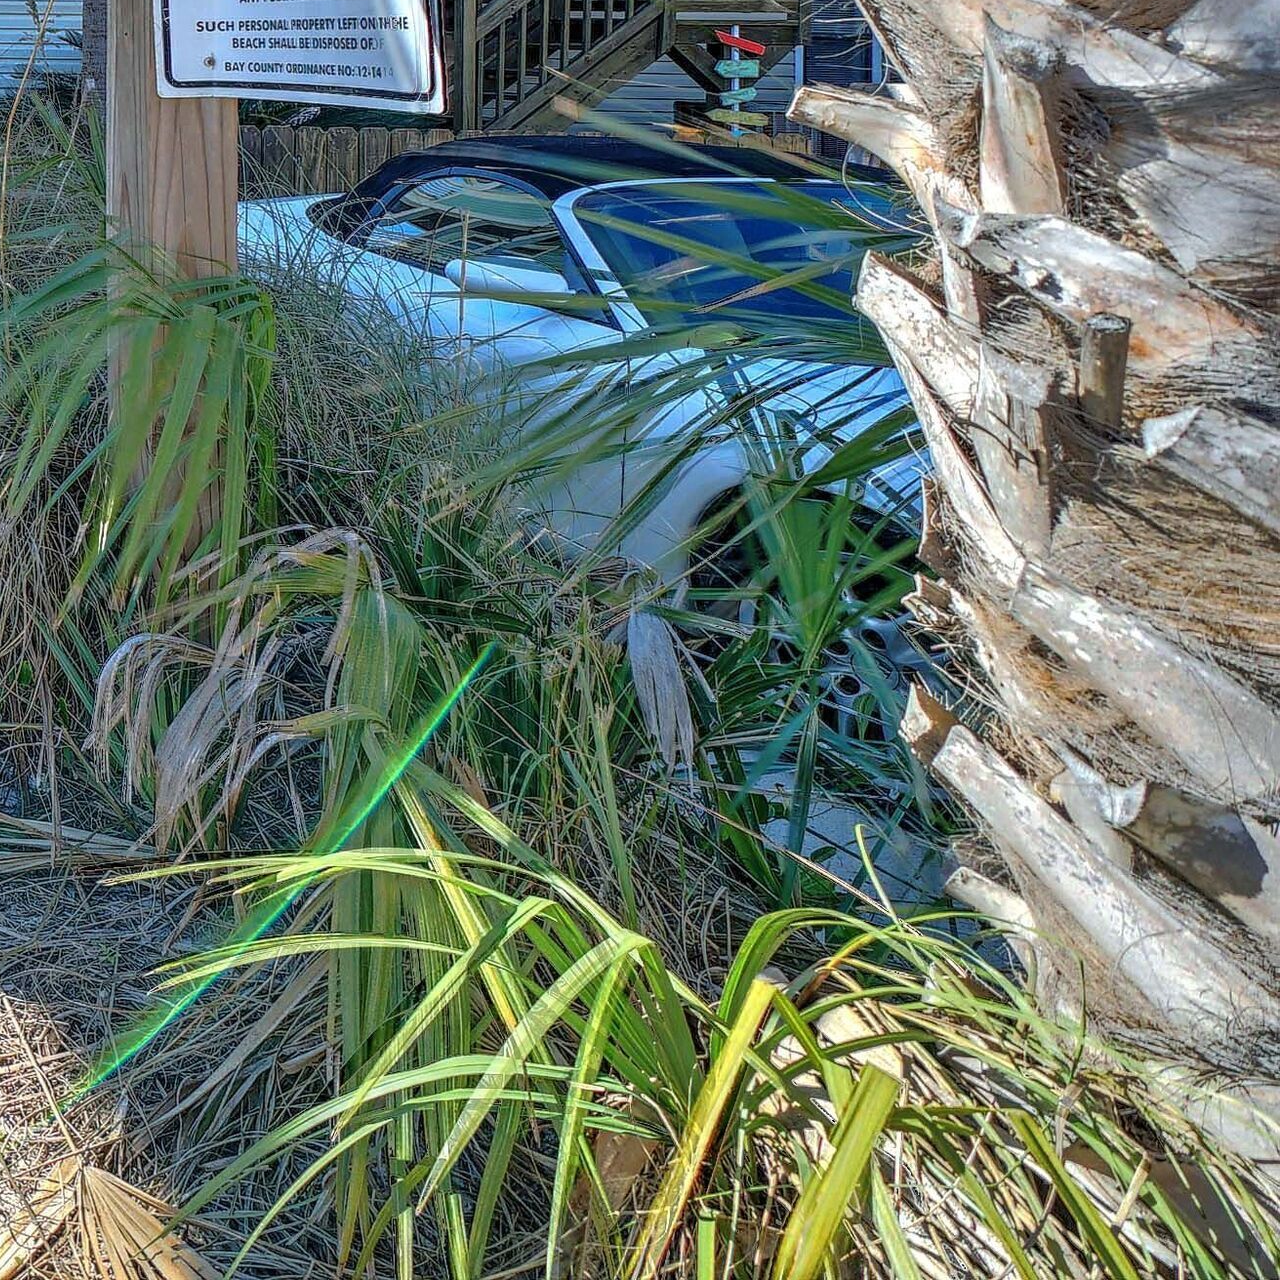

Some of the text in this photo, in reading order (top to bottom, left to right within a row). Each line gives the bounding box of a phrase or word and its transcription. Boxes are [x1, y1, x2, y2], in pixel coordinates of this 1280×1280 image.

[196, 20, 235, 34] SUCH
[238, 18, 290, 32] PERSONAL
[291, 18, 336, 32] PROPERTY
[337, 17, 358, 31] LEFT
[359, 16, 377, 31] ON
[232, 37, 266, 50] BEACH
[268, 37, 298, 51] SHALL
[298, 36, 311, 50] BE
[312, 36, 357, 51] DISPOSED
[225, 61, 246, 73] BAY
[247, 62, 284, 74] COUNTY
[285, 63, 336, 77] ORDINANCE
